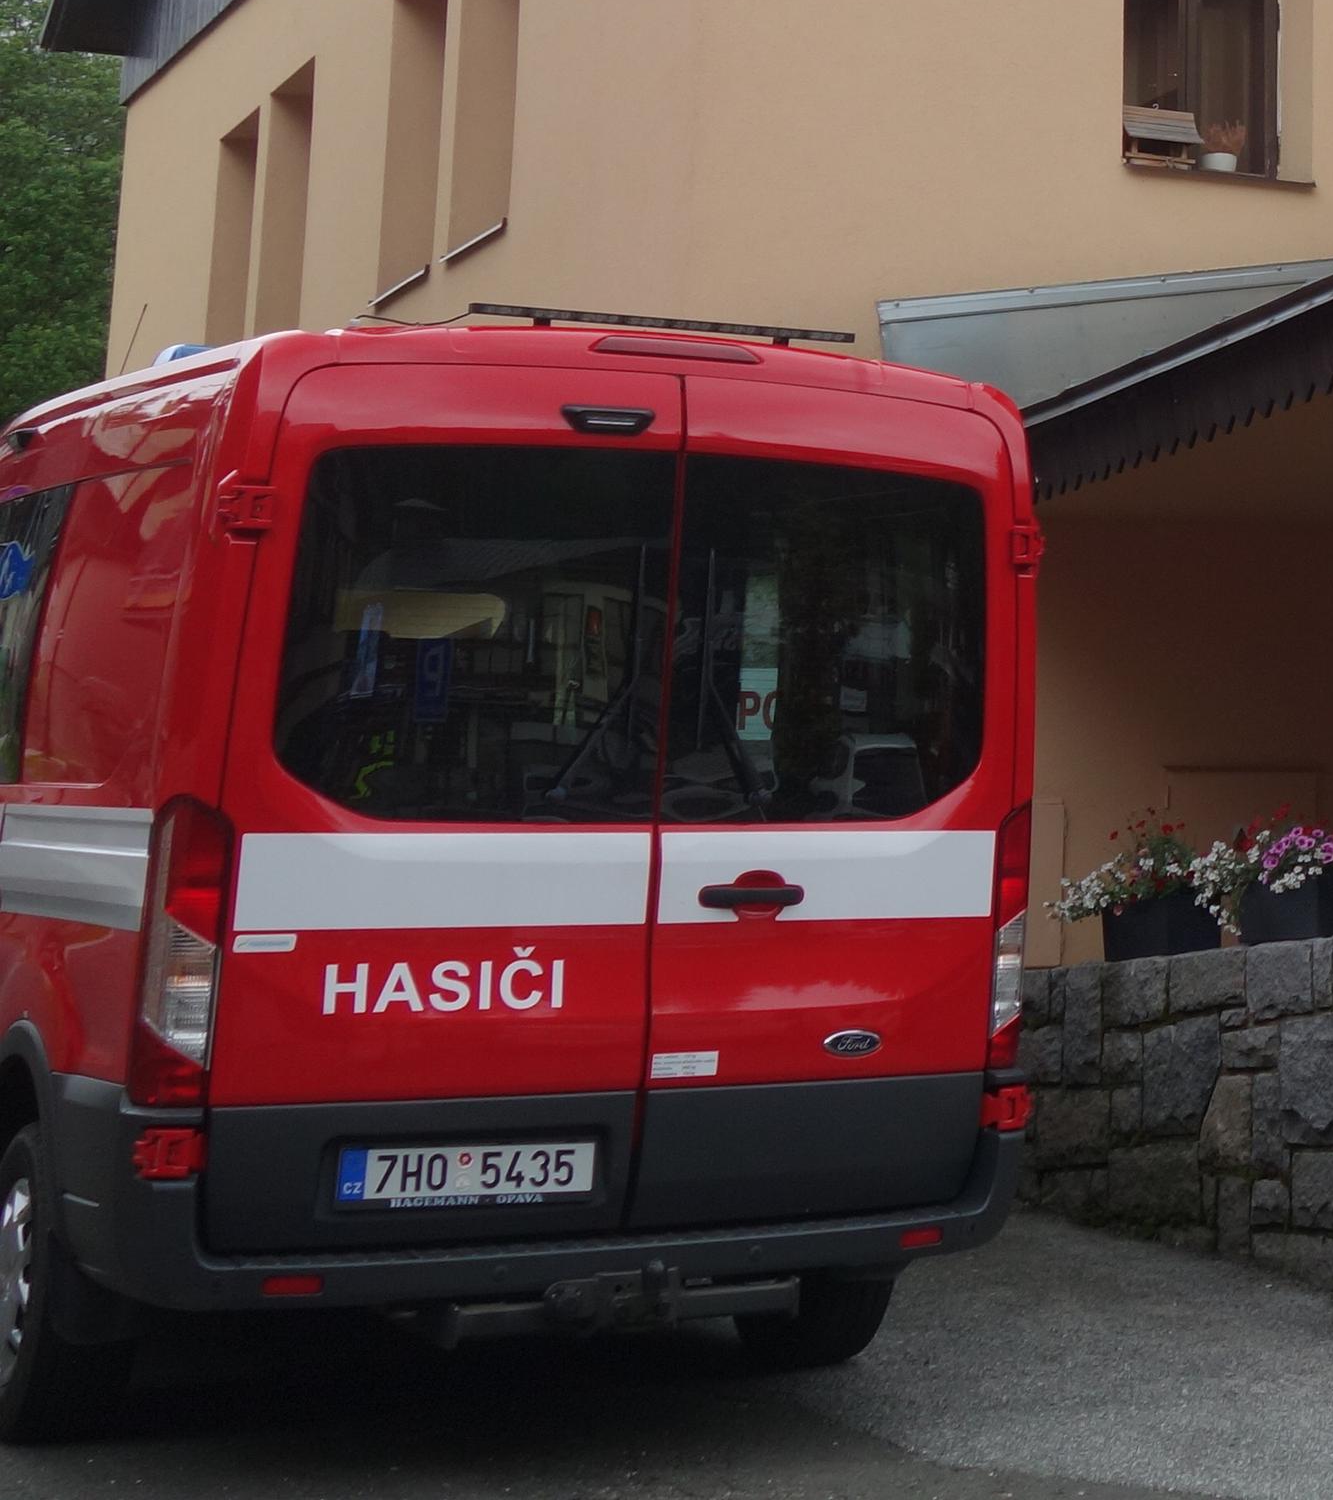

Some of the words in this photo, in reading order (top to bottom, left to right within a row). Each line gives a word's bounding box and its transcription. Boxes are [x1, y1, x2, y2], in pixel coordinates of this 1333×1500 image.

[322, 946, 565, 1016] HASIČI
[837, 1035, 872, 1051] Ford
[342, 1181, 364, 1195] CZ
[375, 1152, 448, 1194] 7H0
[480, 1149, 576, 1190] 5435
[389, 1194, 480, 1209] HAGEMANN
[495, 1192, 543, 1205] OPAVA
